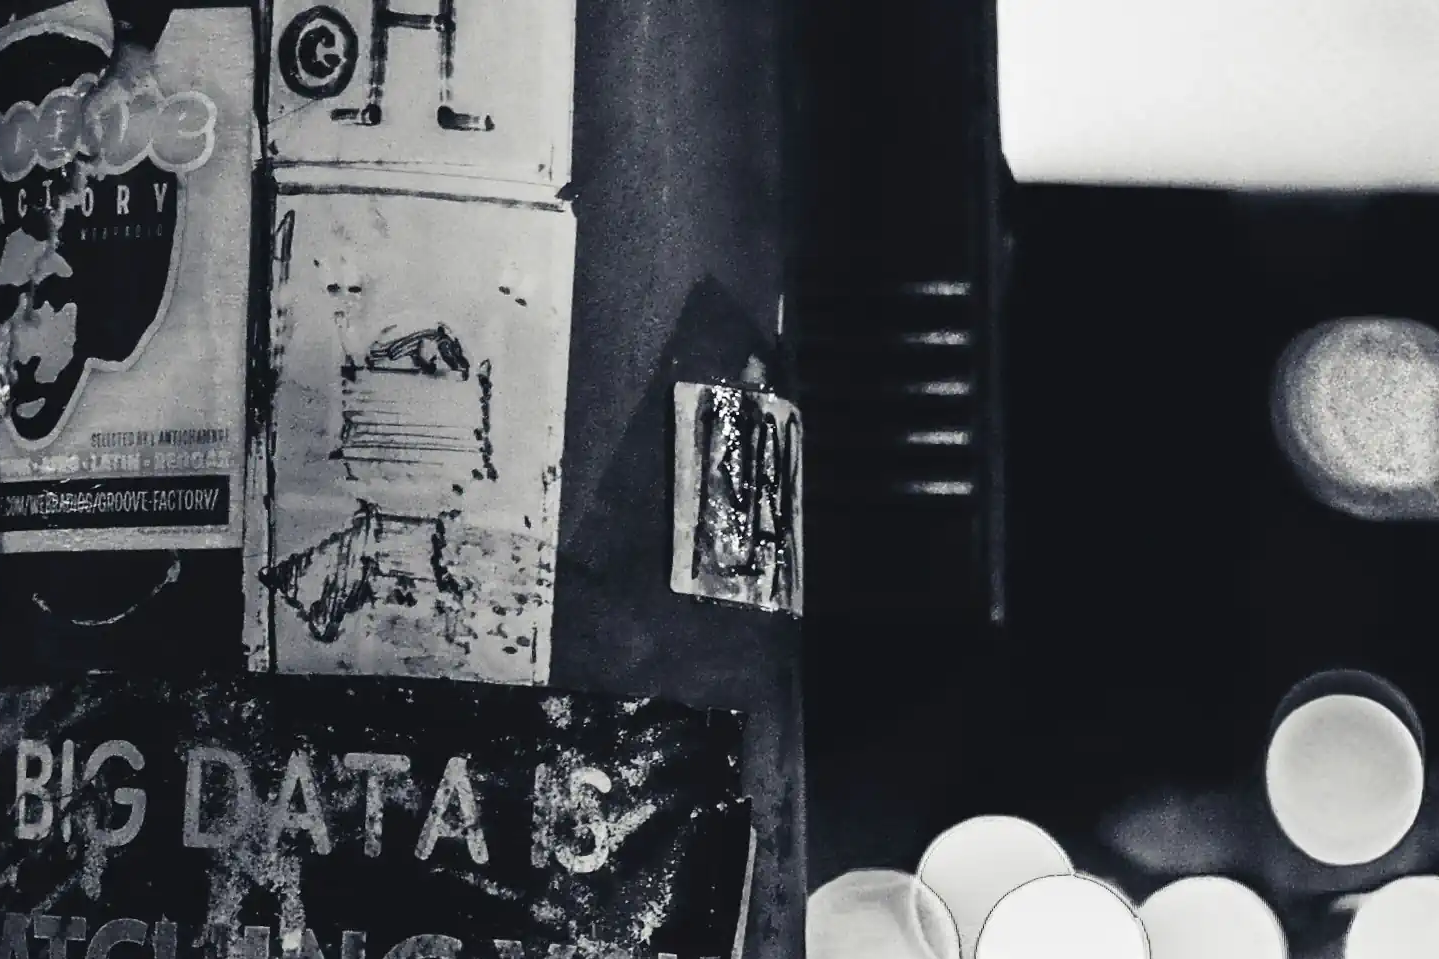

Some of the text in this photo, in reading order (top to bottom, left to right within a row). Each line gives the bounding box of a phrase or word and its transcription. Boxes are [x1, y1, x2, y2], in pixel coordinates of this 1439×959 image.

[15, 739, 613, 874] BIG DATA IS
